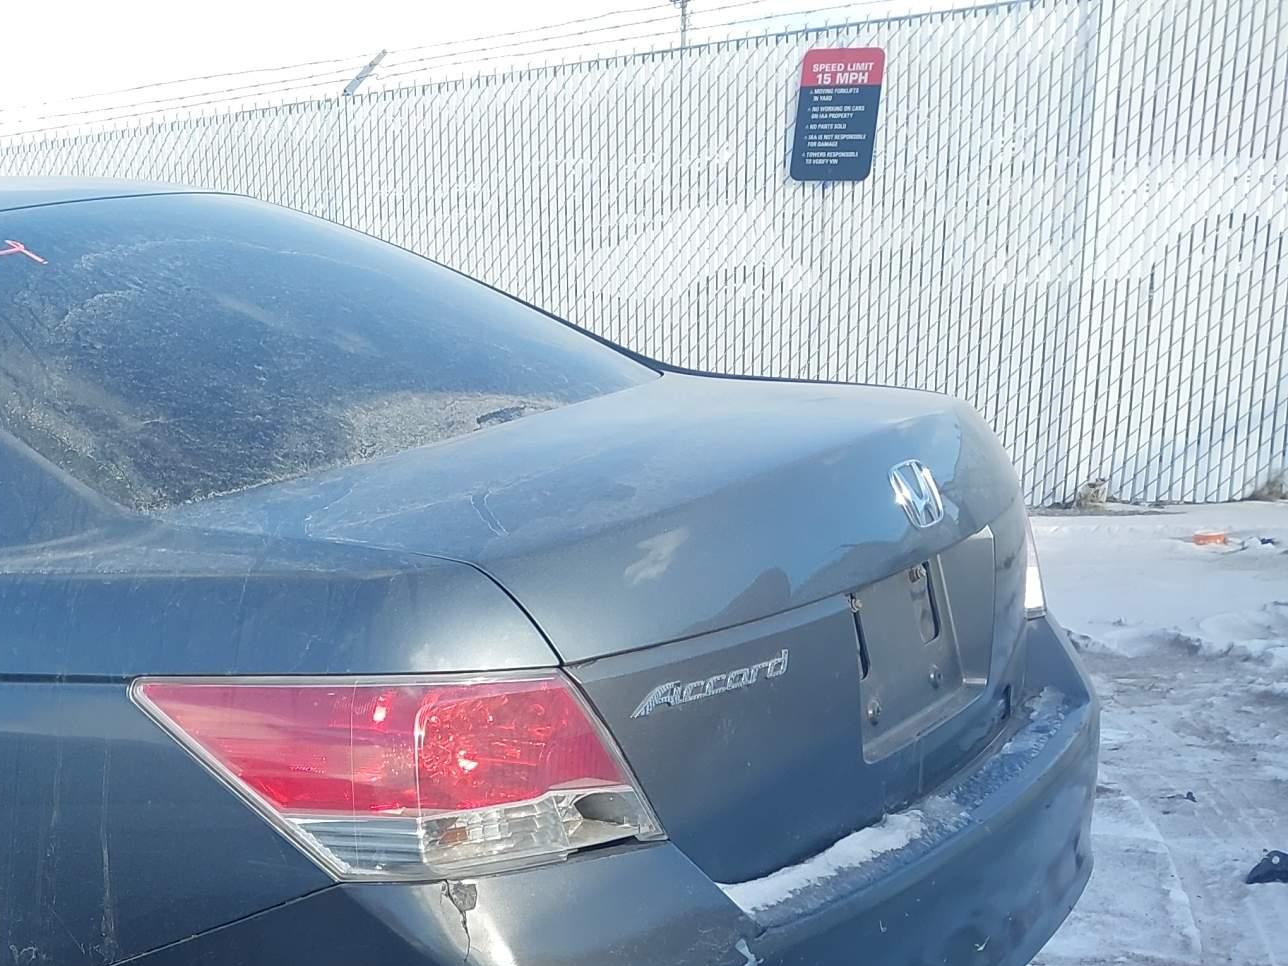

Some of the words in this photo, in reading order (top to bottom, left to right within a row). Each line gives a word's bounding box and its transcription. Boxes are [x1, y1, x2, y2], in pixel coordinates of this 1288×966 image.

[812, 63, 844, 72] SPEED
[848, 62, 874, 72] LIMIT
[816, 74, 831, 85] 15
[836, 73, 868, 84] MPH
[630, 648, 789, 719] Accord
